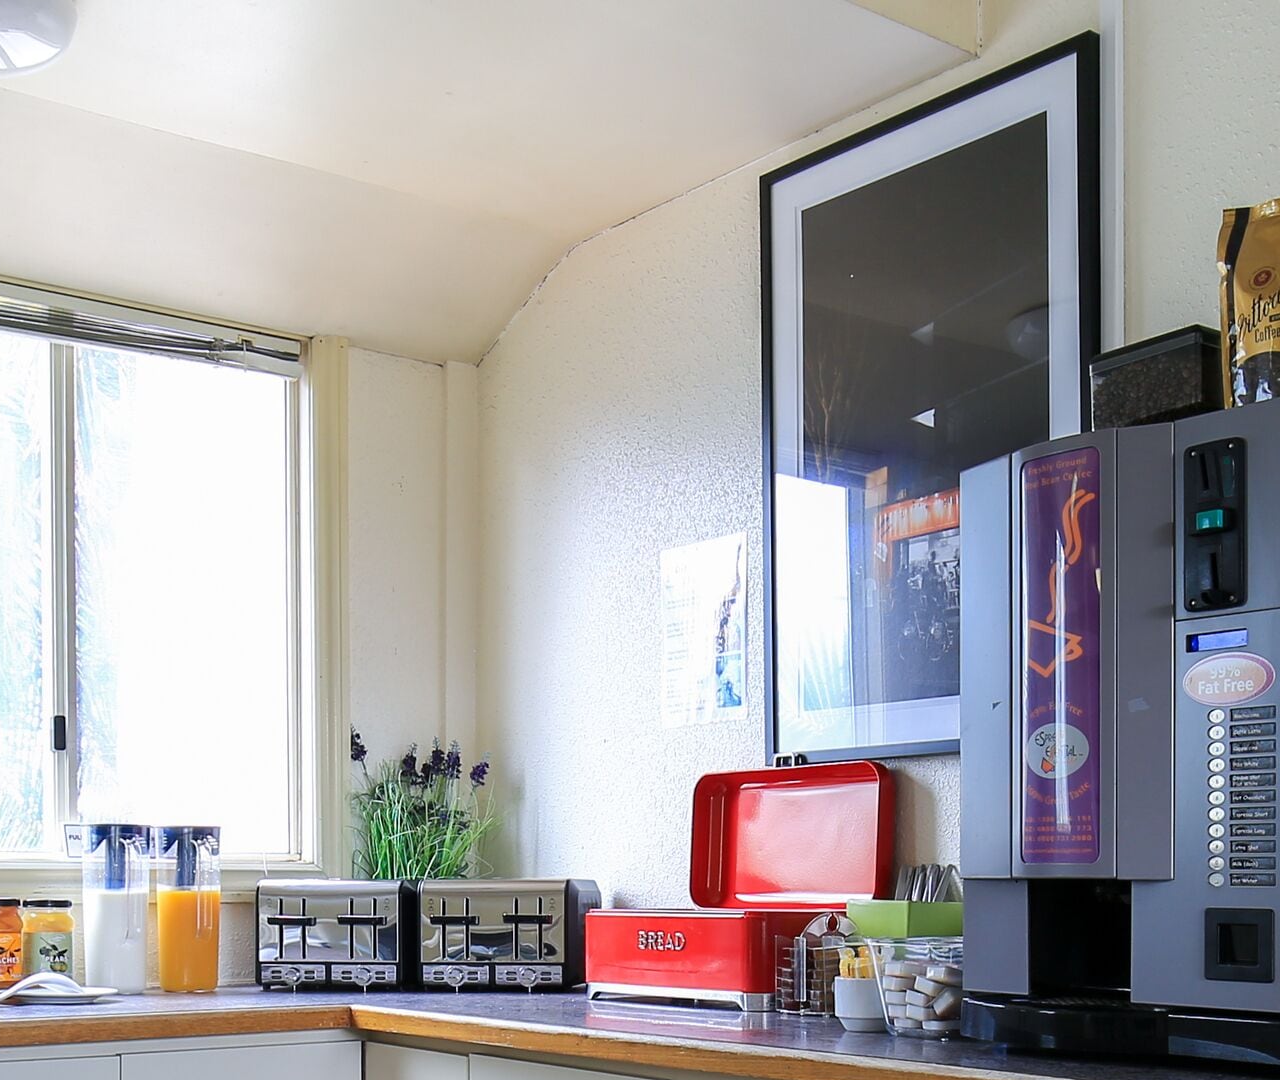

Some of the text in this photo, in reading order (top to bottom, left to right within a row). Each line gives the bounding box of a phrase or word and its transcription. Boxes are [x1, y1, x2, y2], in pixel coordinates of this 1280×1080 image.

[1254, 326, 1280, 343] Coffee
[1210, 665, 1241, 678] 99%
[1198, 678, 1254, 694] Fat Free
[637, 929, 685, 952] BREAD
